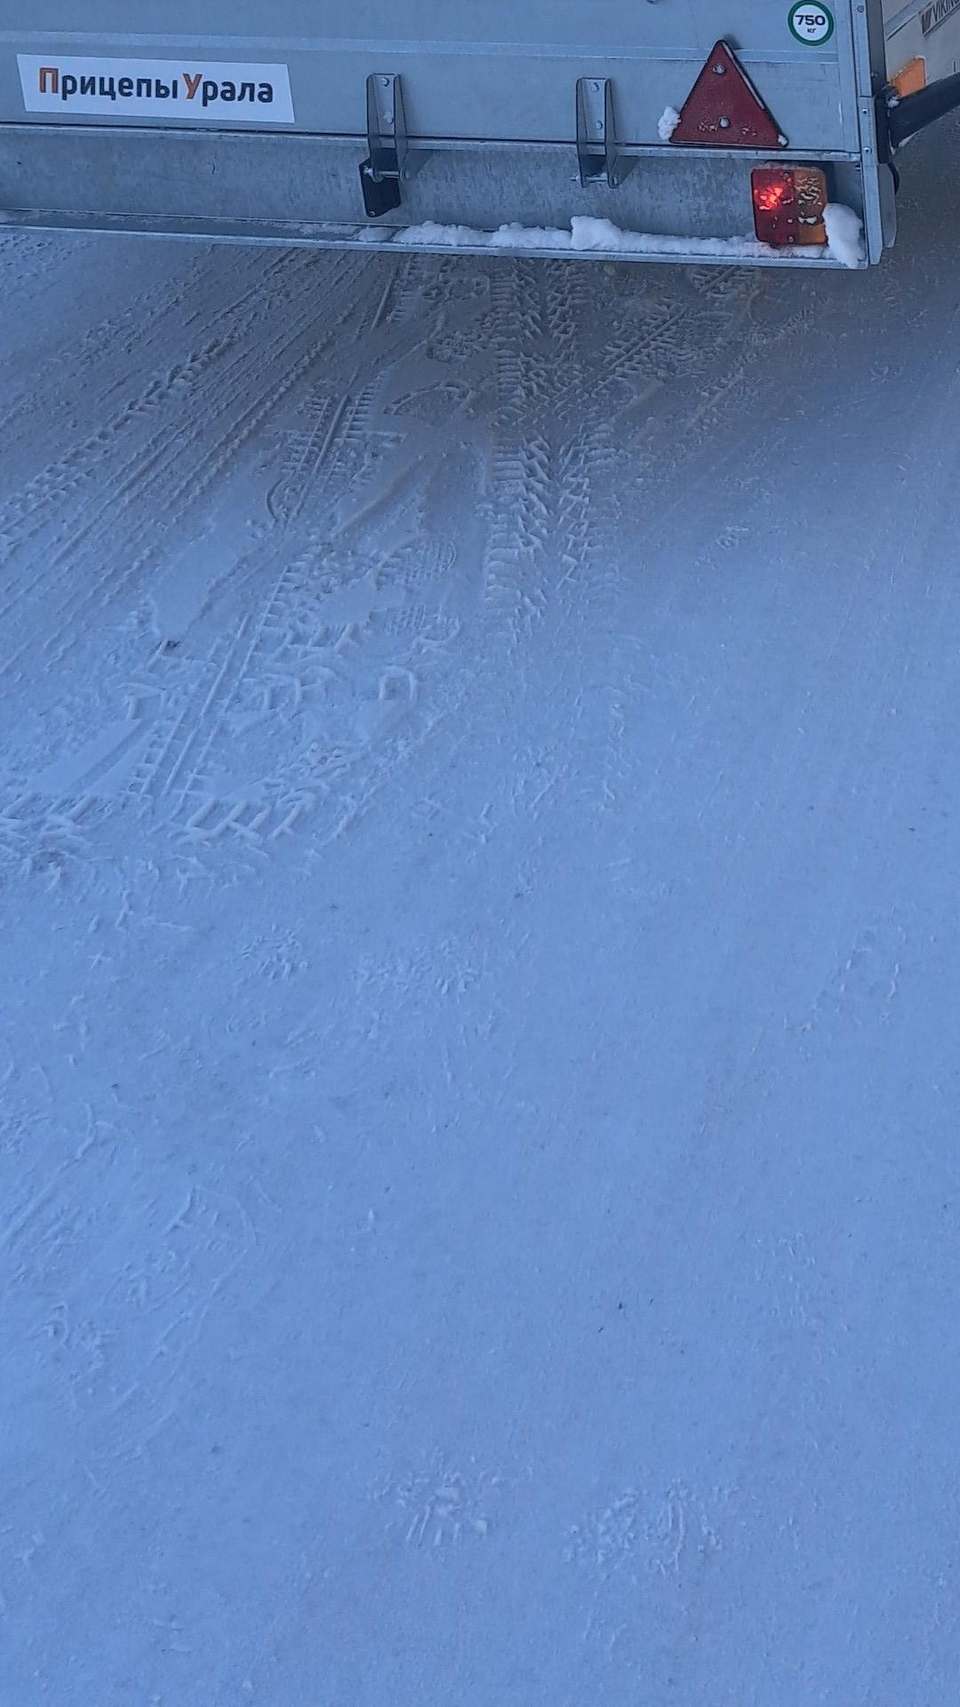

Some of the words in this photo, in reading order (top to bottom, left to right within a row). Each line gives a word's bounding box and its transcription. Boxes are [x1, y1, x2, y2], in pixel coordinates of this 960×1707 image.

[794, 14, 826, 26] 750
[39, 67, 178, 101] Прицепы
[182, 72, 274, 107] Урала
